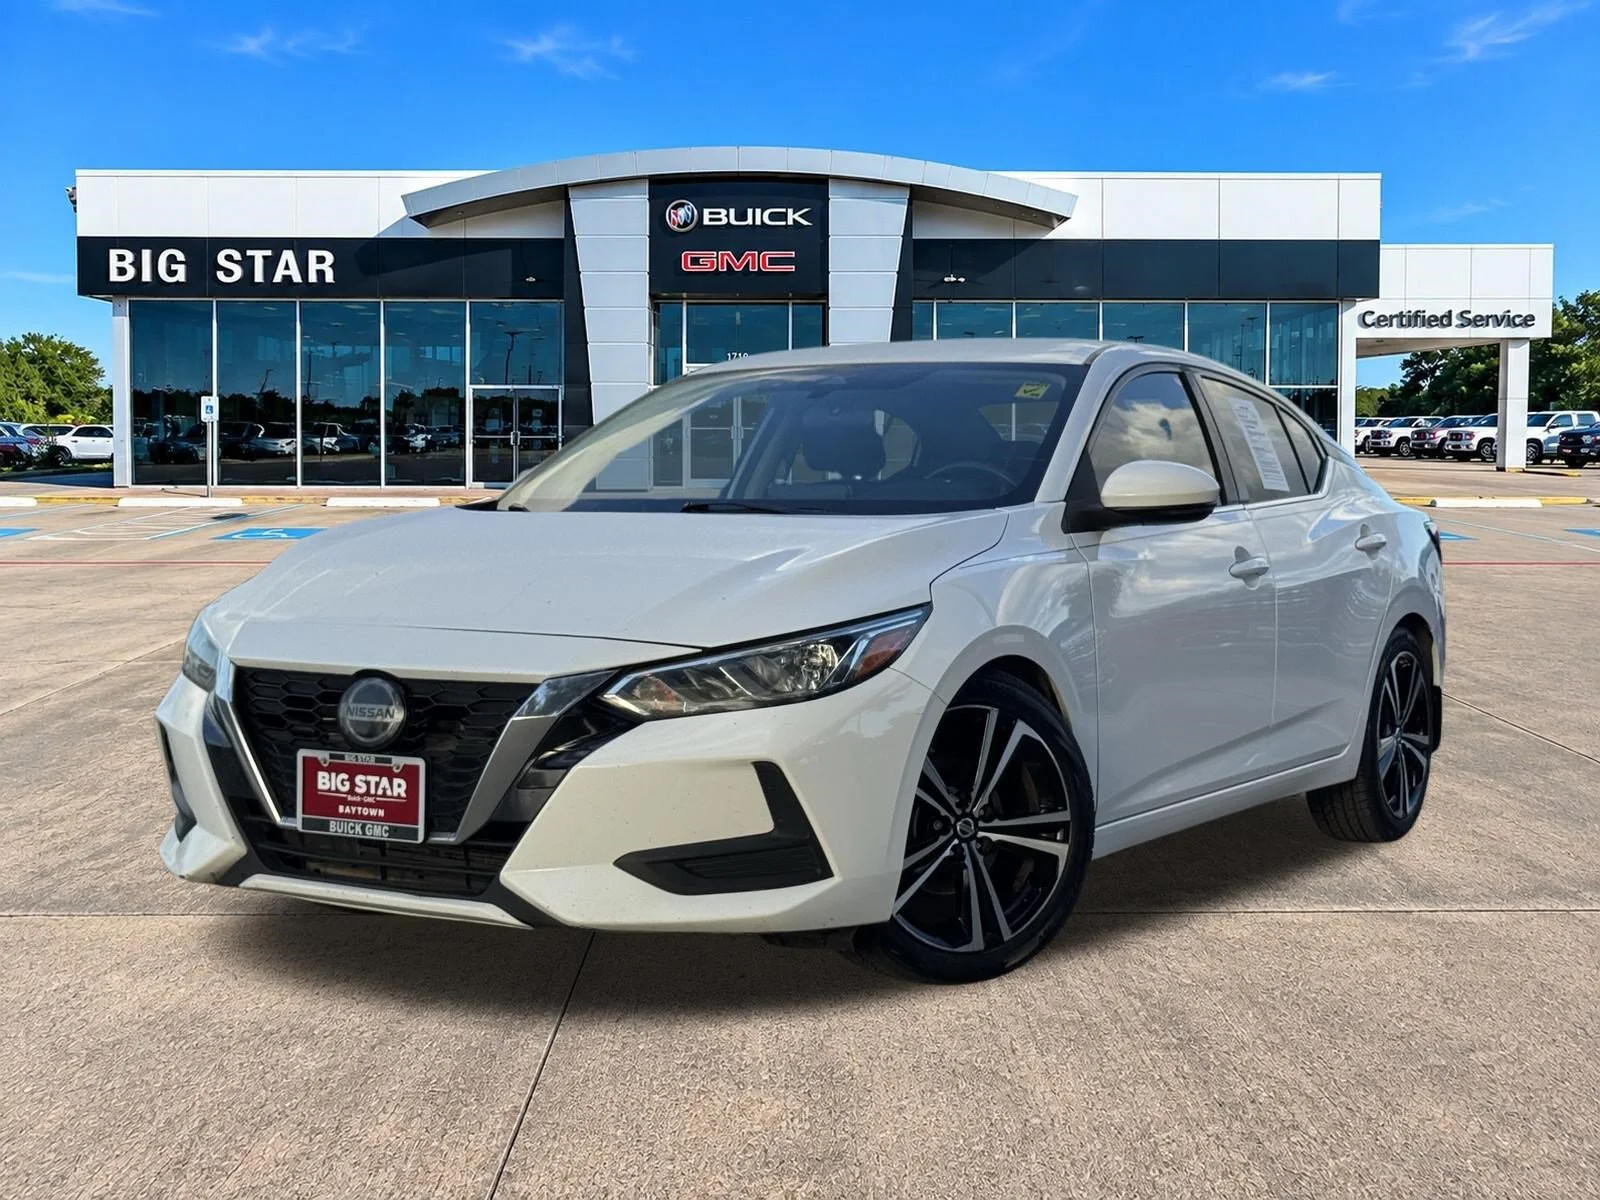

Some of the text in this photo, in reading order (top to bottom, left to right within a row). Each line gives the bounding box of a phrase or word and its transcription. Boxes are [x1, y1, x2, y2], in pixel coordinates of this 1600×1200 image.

[702, 207, 813, 226] BUICK
[108, 249, 336, 283] BIG STAR
[681, 251, 796, 272] GMC
[1359, 310, 1536, 328] Certified Service
[346, 706, 396, 719] NISSAN
[317, 771, 407, 798] BIG STAR
[338, 805, 385, 817] BAYTOWN
[329, 820, 390, 838] BUICK GMC
